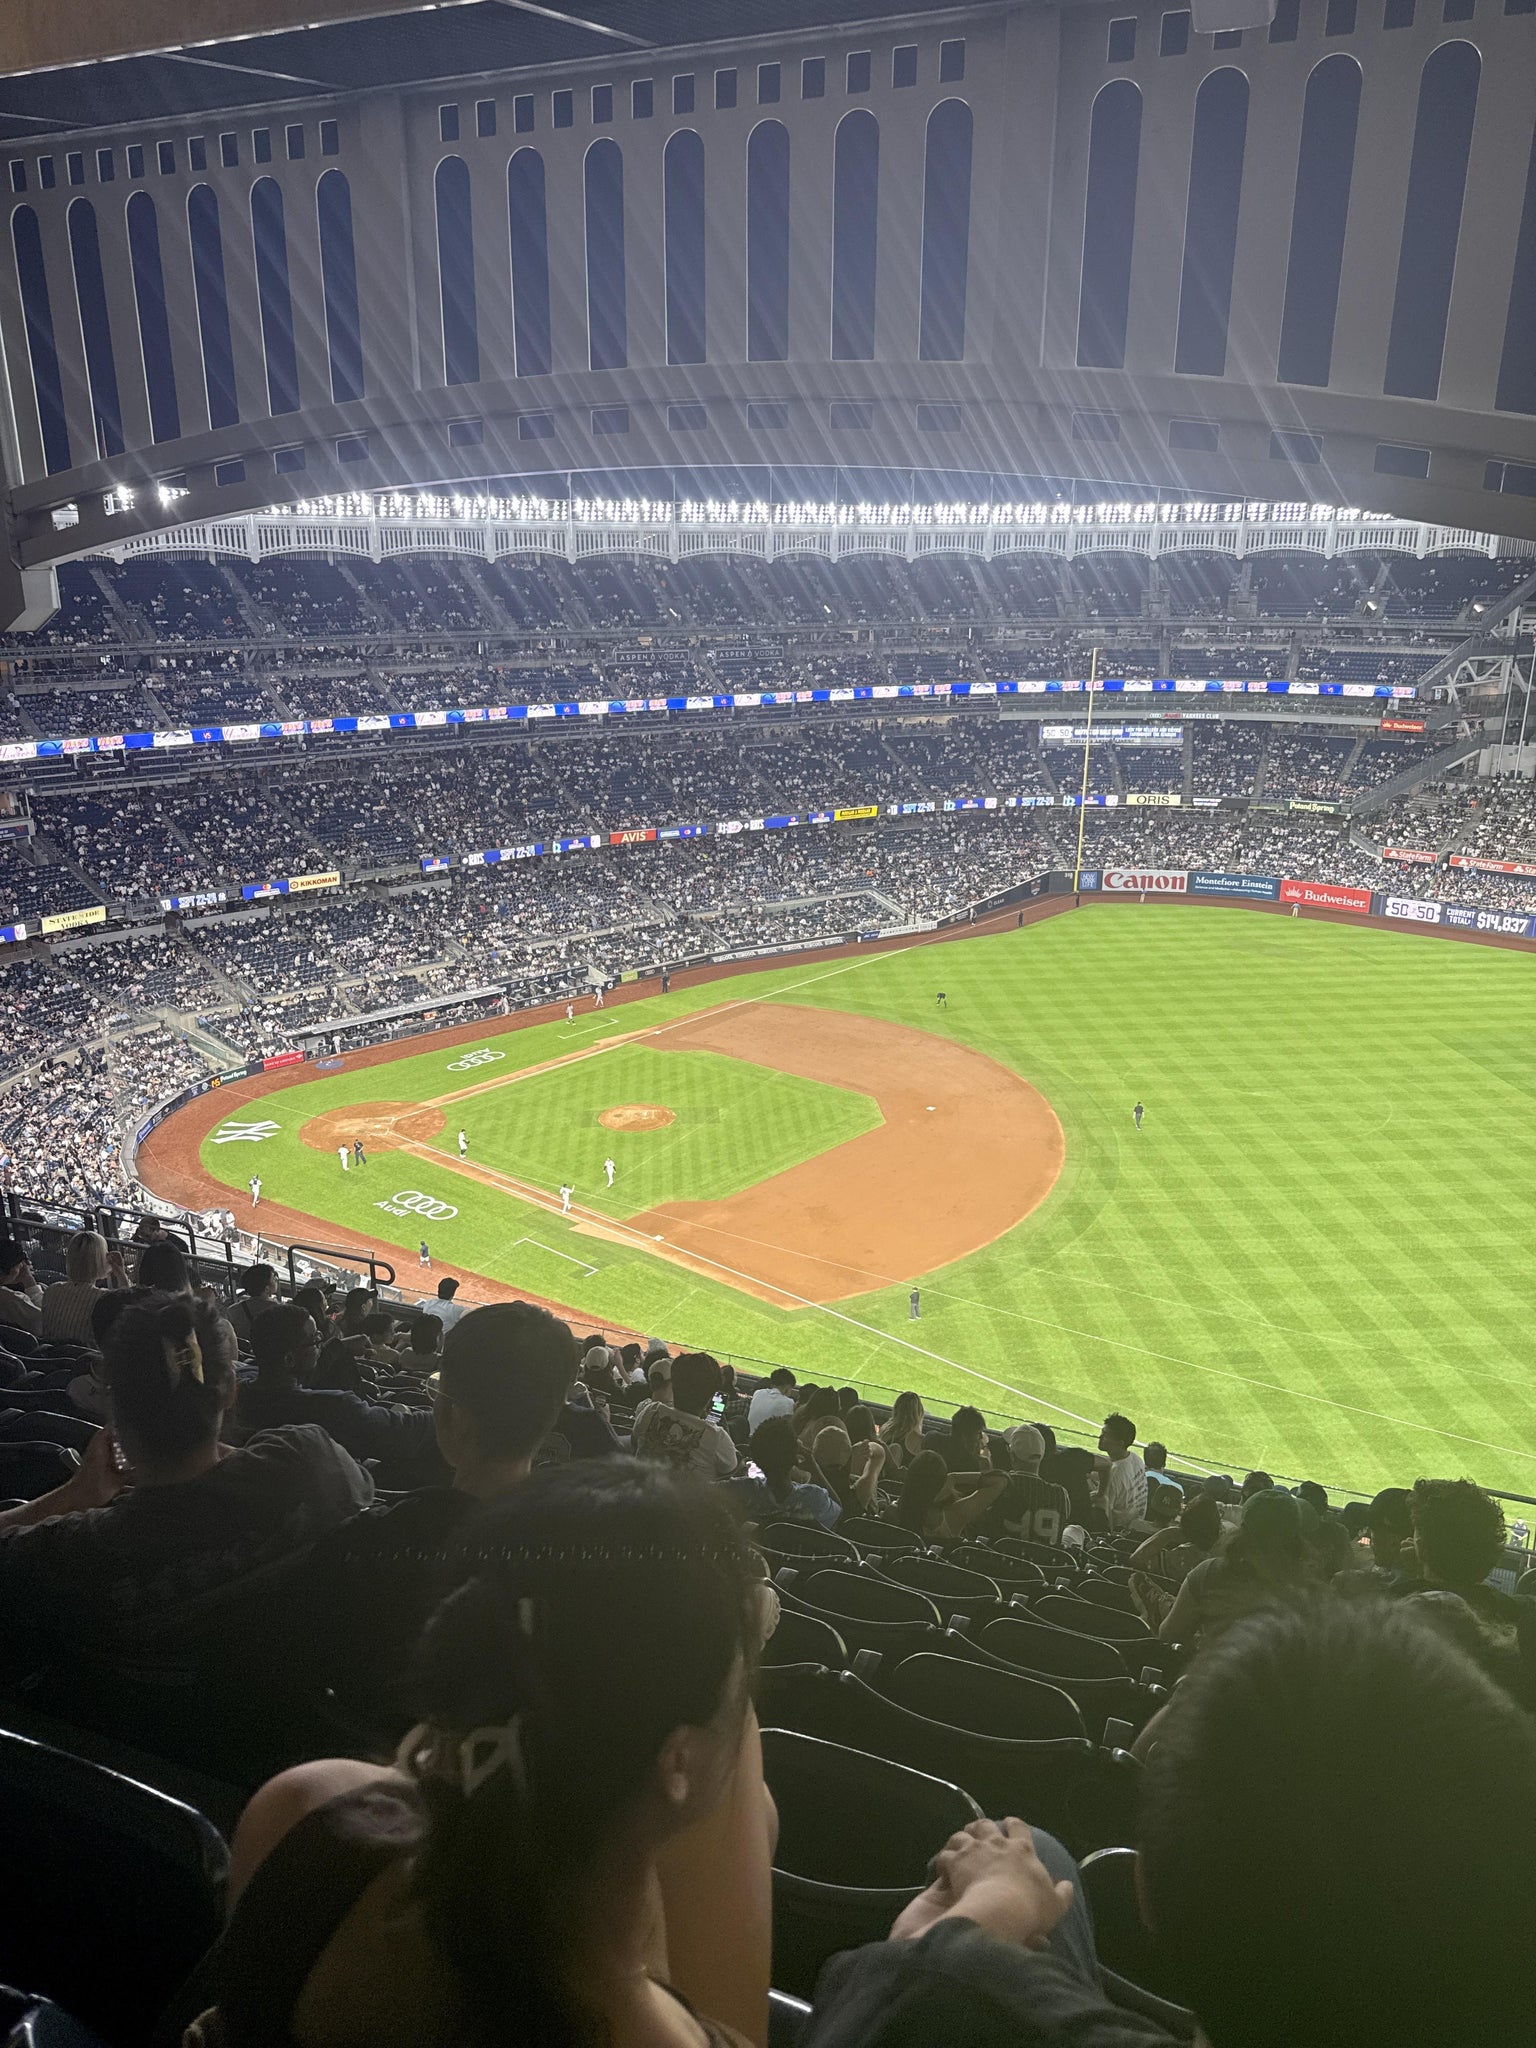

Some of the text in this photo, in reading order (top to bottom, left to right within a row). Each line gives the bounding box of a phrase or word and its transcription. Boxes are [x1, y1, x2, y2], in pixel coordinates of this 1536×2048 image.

[658, 652, 685, 660] VODKA
[719, 649, 780, 658] ASPEN VODKA
[1393, 722, 1423, 730] Budweiser
[1136, 795, 1170, 805] ORIS
[1289, 801, 1335, 813] Poland Spring
[620, 831, 646, 844] AVIS
[468, 852, 485, 866] RAYS
[1398, 850, 1432, 862] State Farm
[1469, 859, 1504, 871] State Farm
[300, 876, 338, 887] KIKKOMAN
[1103, 871, 1186, 890] Canon
[1195, 876, 1273, 890] Montefiore Einstein
[1303, 889, 1367, 908] Budweiser
[1391, 902, 1435, 920] 50 50
[1446, 907, 1476, 919] CURRENT
[1476, 911, 1529, 934] $14,837
[372, 1200, 412, 1217] Audi
